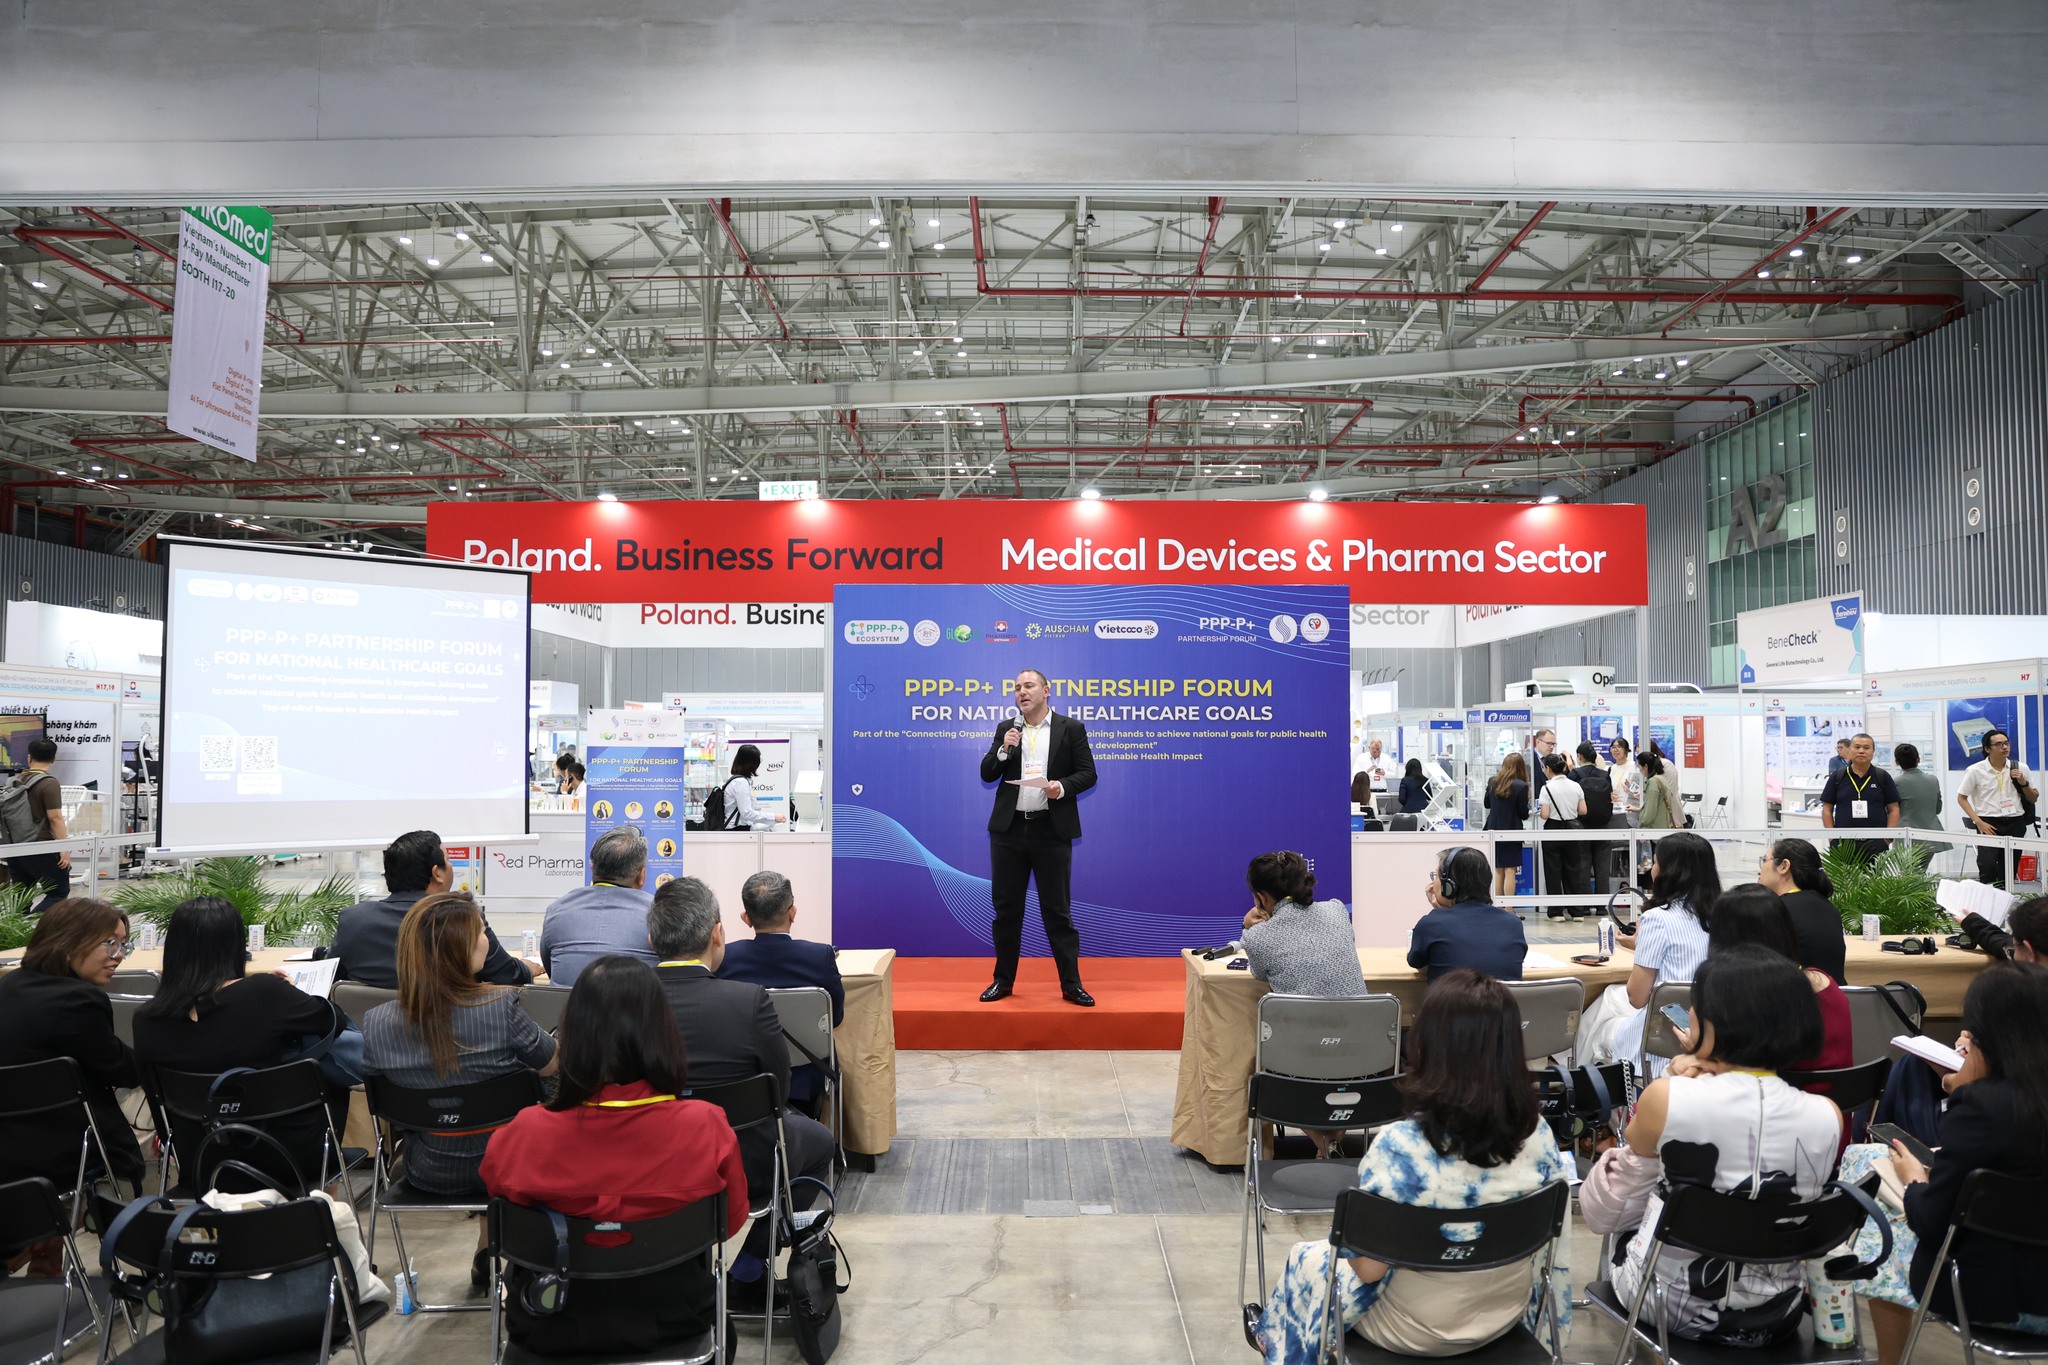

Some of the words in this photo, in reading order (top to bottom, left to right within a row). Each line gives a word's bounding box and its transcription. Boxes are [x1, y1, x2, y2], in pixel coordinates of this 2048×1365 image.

[184, 221, 218, 251] Vietnam's
[220, 244, 247, 269] Number
[183, 238, 204, 261] X-Ray
[205, 252, 250, 287] Manufacturer
[181, 260, 210, 285] BOOTH
[771, 484, 805, 496] EXIT
[1725, 474, 1788, 557] A2
[464, 539, 602, 572] Poland.
[615, 539, 774, 571] Business
[787, 538, 944, 571] Forward
[1001, 537, 1147, 572] Medical
[1158, 538, 1298, 572] Devices
[1306, 538, 1333, 572] &
[1343, 538, 1485, 573] Pharma
[1494, 539, 1608, 575] Sector
[641, 603, 737, 625] Poland.
[1352, 604, 1430, 625] Sector
[866, 624, 905, 633] PPP-P+
[1044, 624, 1090, 633] AUSCHAM
[1199, 617, 1256, 630] PPP-P+
[226, 628, 299, 645] PPP-P+
[305, 632, 435, 653] PARTNERSHIP
[440, 640, 502, 657] FORUM
[214, 651, 251, 665] FOR
[255, 652, 343, 669] NATIONAL
[347, 657, 450, 674] HEALTHCARE
[454, 662, 504, 676] GOALS
[1785, 658, 1810, 667] Biotechnology
[226, 672, 246, 681] Part
[247, 673, 257, 681] of
[258, 673, 273, 682] the
[905, 679, 994, 696] PPP-P+
[1002, 679, 1175, 697] PTNERSHIP
[1183, 679, 1273, 697] FORUM
[911, 706, 953, 720] FOR
[1067, 705, 1200, 721] HEALTHCARE
[1205, 705, 1273, 721] GOALS
[73, 720, 97, 729] khám
[77, 734, 91, 744] gia
[853, 730, 872, 738] Part
[873, 730, 883, 738] of
[884, 730, 900, 738] the
[958, 730, 996, 739] Organiza
[1086, 730, 1115, 739] oining
[1116, 730, 1144, 738] hands
[1156, 730, 1191, 738] achieve
[1192, 730, 1229, 738] national
[1230, 730, 1254, 740] goals
[1255, 730, 1268, 738] for
[1270, 730, 1297, 740] public
[1298, 730, 1327, 738] health
[1092, 752, 1138, 760] ustainable
[1140, 752, 1170, 760] Health
[1171, 752, 1203, 761] Impact
[497, 853, 523, 868] Red
[528, 855, 584, 868] Pharma
